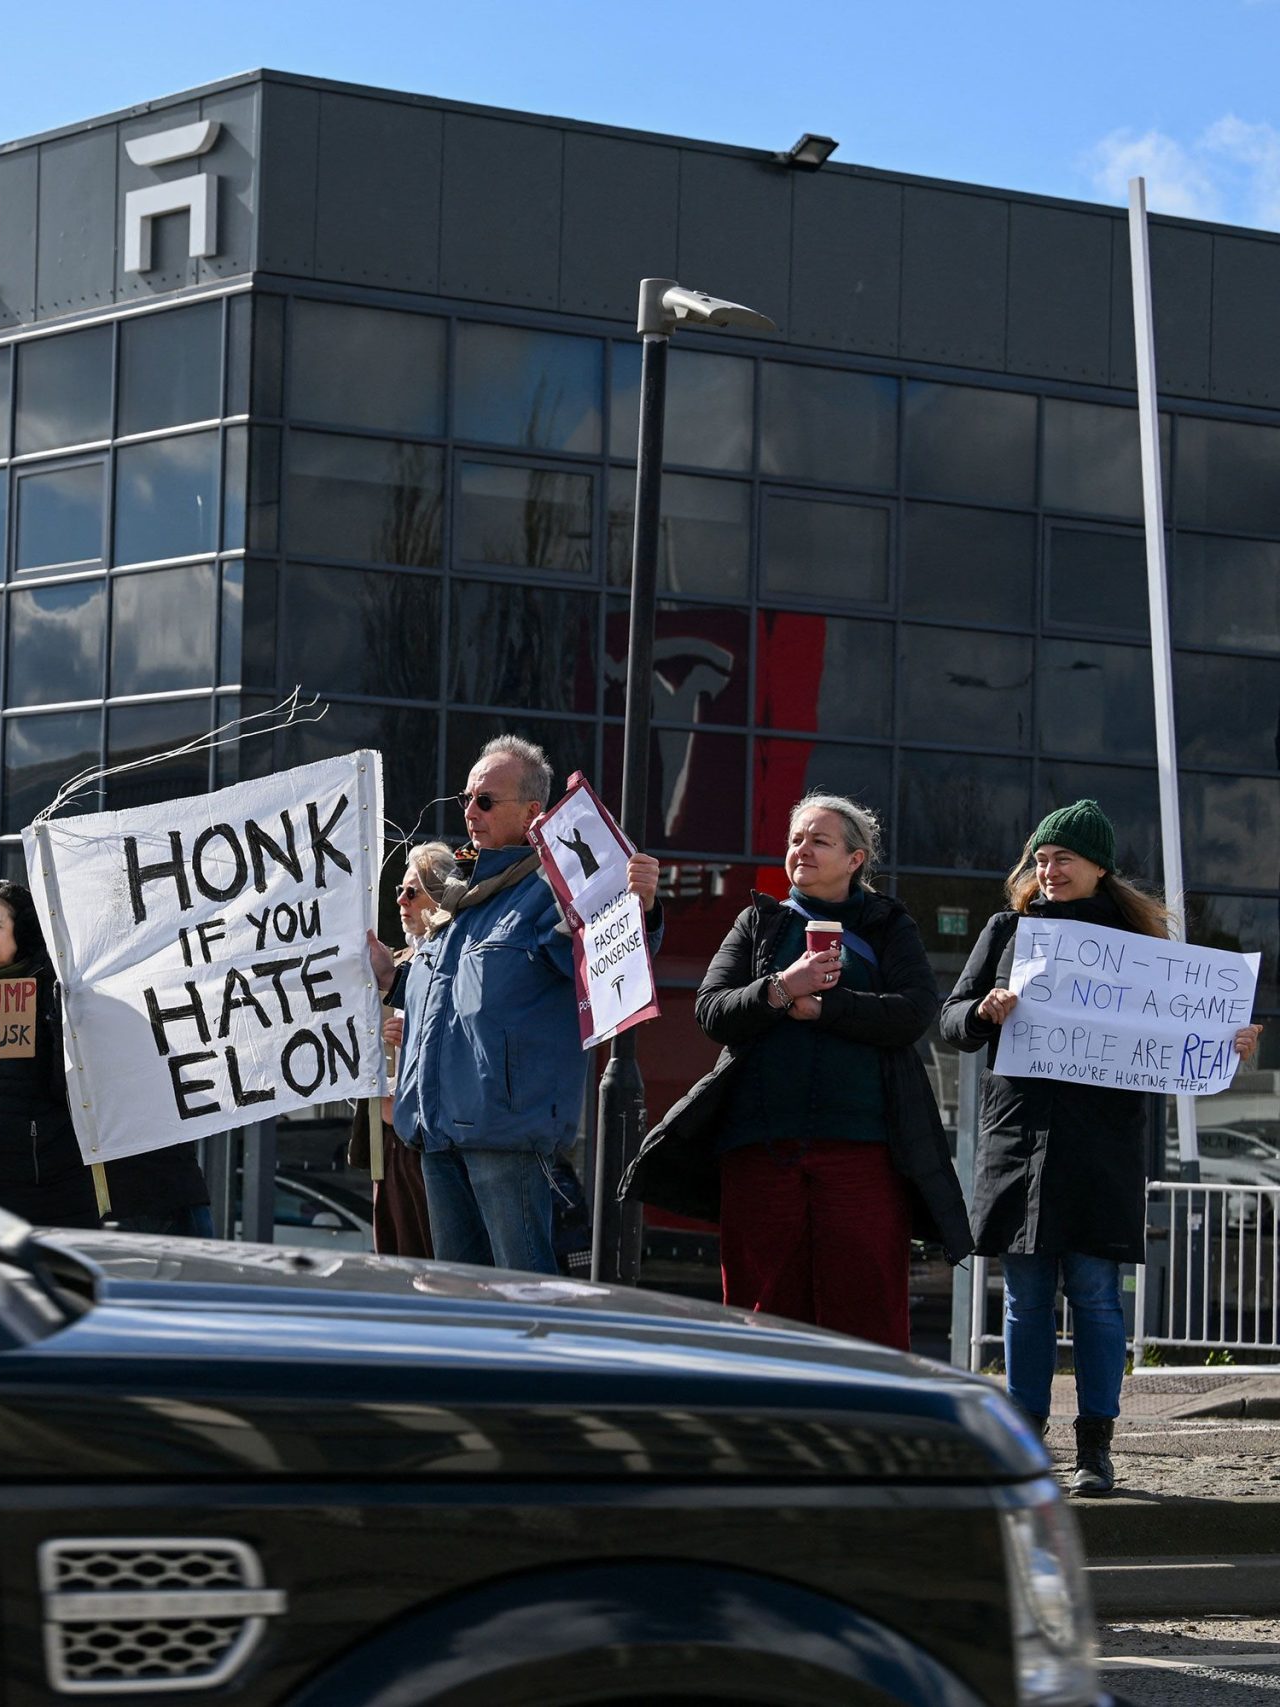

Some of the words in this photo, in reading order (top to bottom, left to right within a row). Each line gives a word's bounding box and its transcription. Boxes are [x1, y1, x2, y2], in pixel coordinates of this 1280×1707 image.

[123, 794, 353, 925] HONK
[178, 918, 226, 968] IF
[246, 897, 323, 952] YOU
[589, 930, 642, 981] NONSENSE
[593, 912, 630, 954] FASCIST
[1030, 932, 1125, 974] ELON
[1156, 956, 1240, 992] THIS
[142, 945, 343, 1057] HATE
[1020, 974, 1053, 1003] IS
[1071, 979, 1133, 1013] NOT
[1141, 990, 1159, 1018] A
[1169, 993, 1250, 1024] GAME
[167, 1015, 362, 1120] ELON
[1011, 1020, 1118, 1062] PEOPLE
[1131, 1038, 1174, 1070] ARE
[1180, 1032, 1234, 1081] REAL
[1029, 1060, 1053, 1073] AND
[1059, 1061, 1108, 1081] YOU'RE
[1115, 1071, 1169, 1090] HURTING
[1173, 1078, 1209, 1093] THEM
